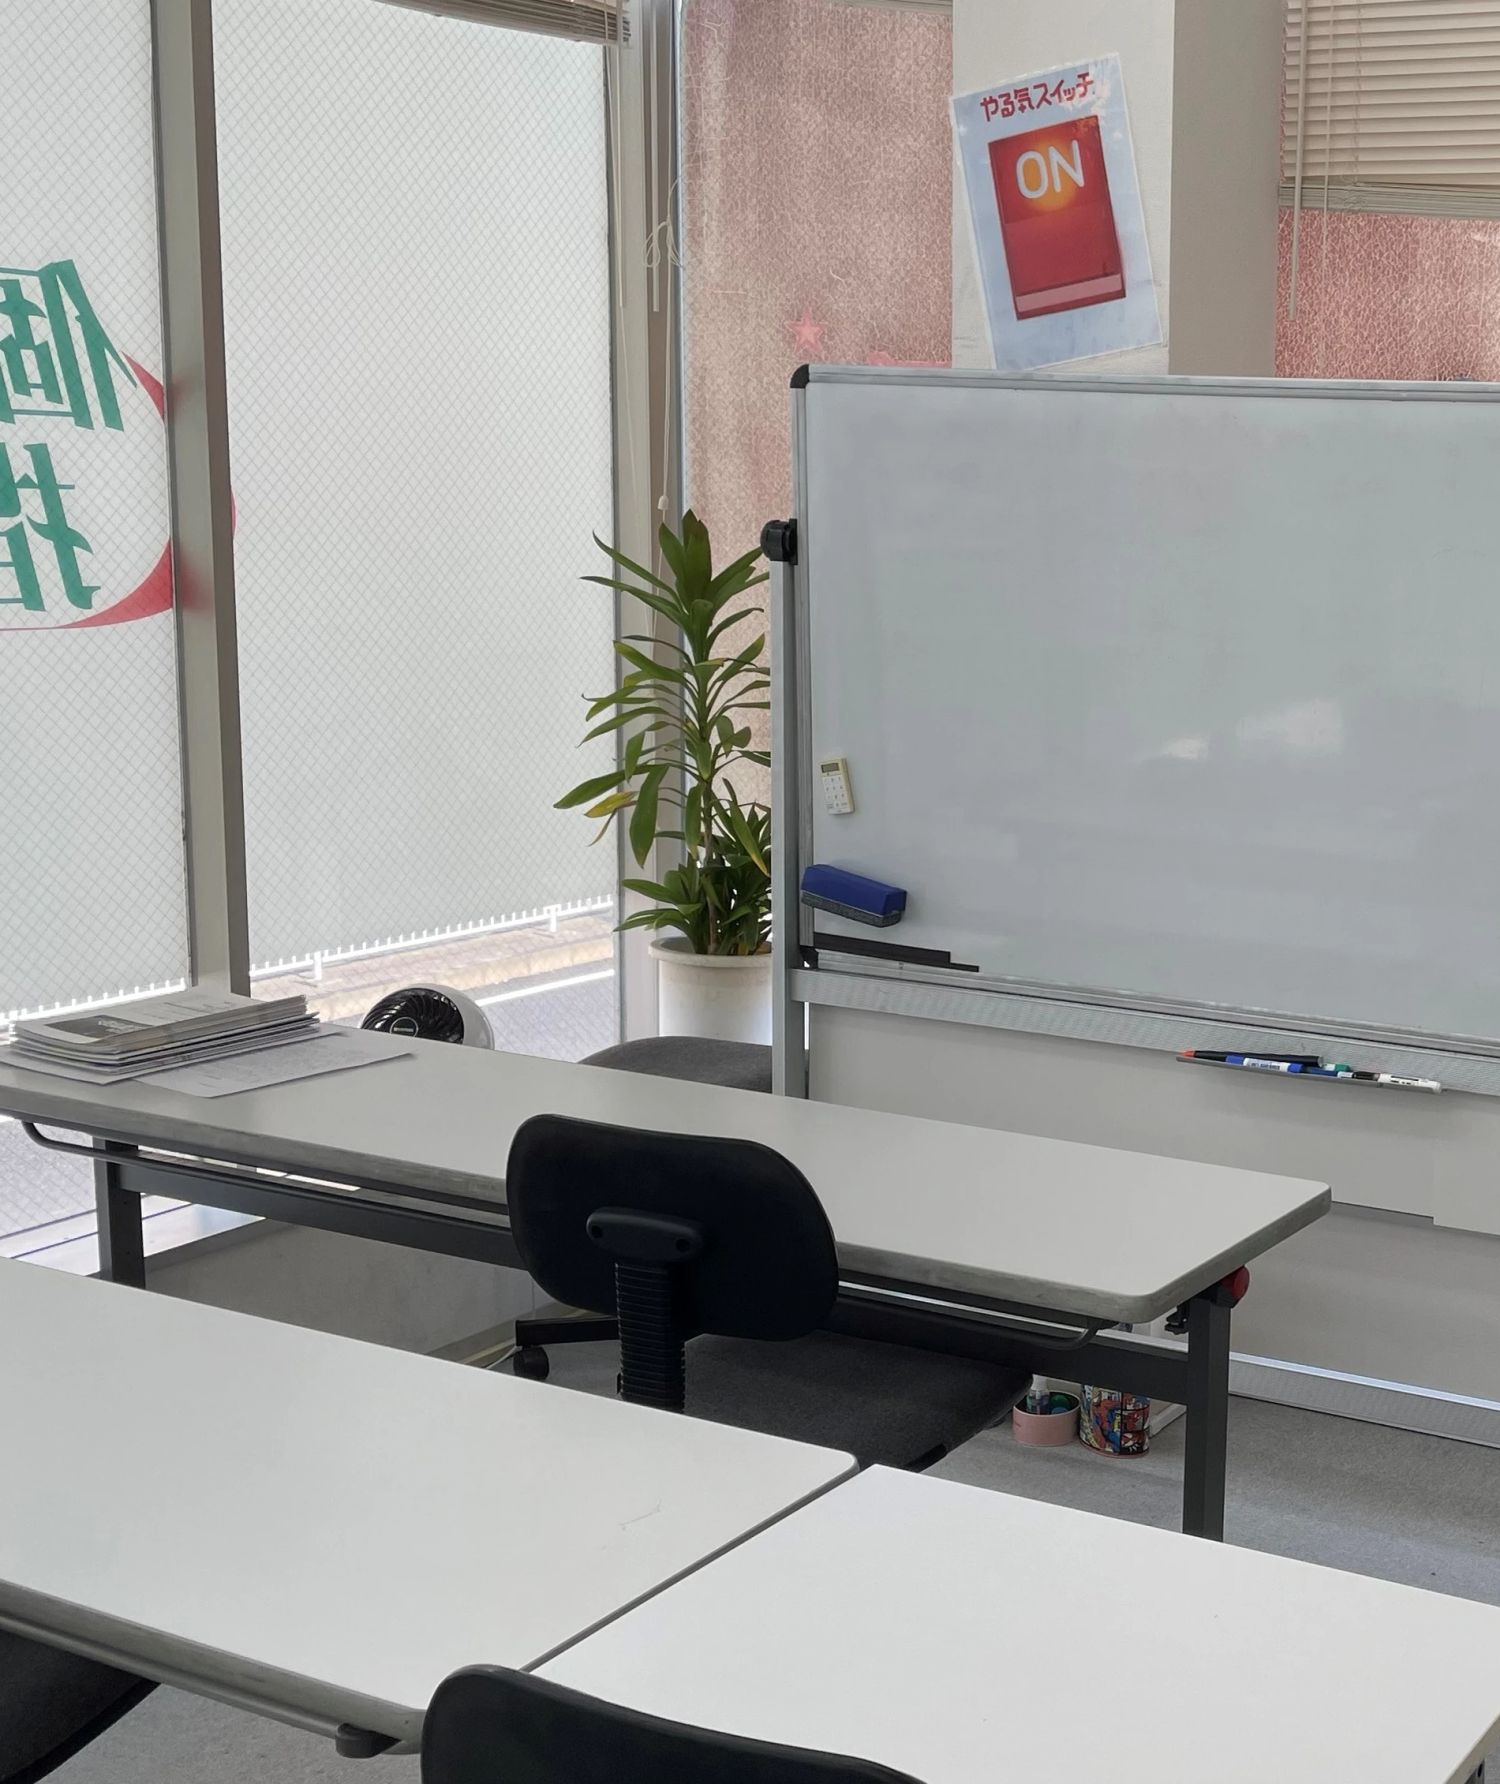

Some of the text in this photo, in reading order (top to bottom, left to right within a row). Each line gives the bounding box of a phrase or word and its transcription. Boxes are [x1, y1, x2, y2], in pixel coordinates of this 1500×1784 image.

[980, 72, 1094, 122] やる気スイッチ
[1015, 139, 1086, 199] ON
